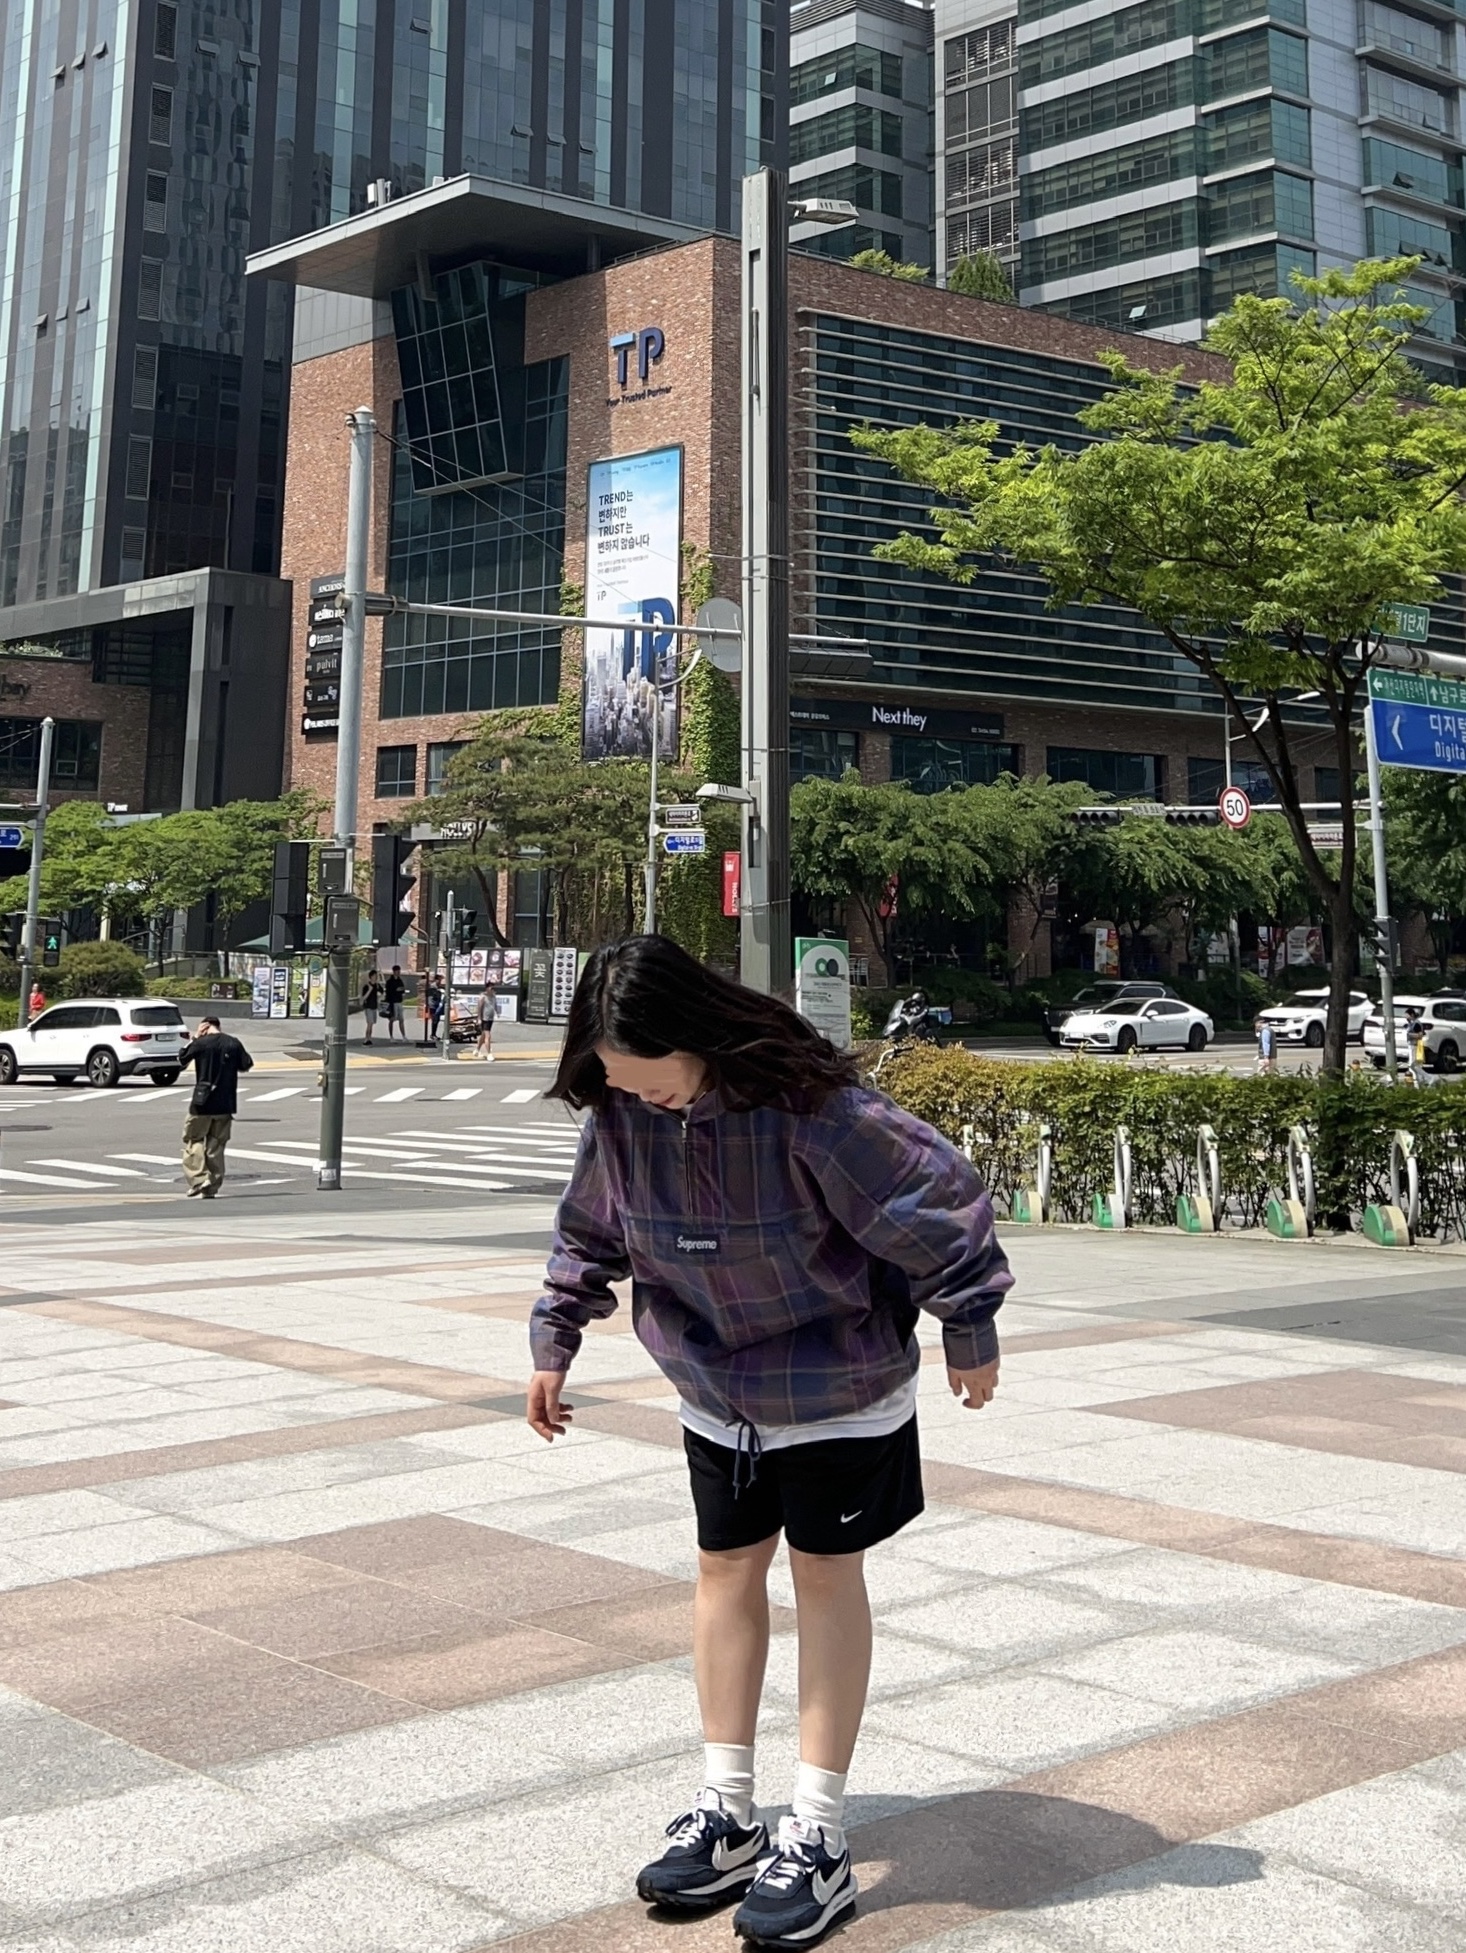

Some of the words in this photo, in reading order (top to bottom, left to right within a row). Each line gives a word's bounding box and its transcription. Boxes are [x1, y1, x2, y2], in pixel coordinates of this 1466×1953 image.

[609, 326, 665, 385] TP
[598, 489, 633, 506] TREND는
[598, 505, 627, 524] 변하지만
[597, 521, 633, 537] TRUST는
[597, 537, 619, 554] 변하지
[620, 533, 650, 551] 않습니다
[1226, 799, 1244, 816] 50
[533, 963, 547, 979] 꽃
[676, 1234, 718, 1253] Supreme
